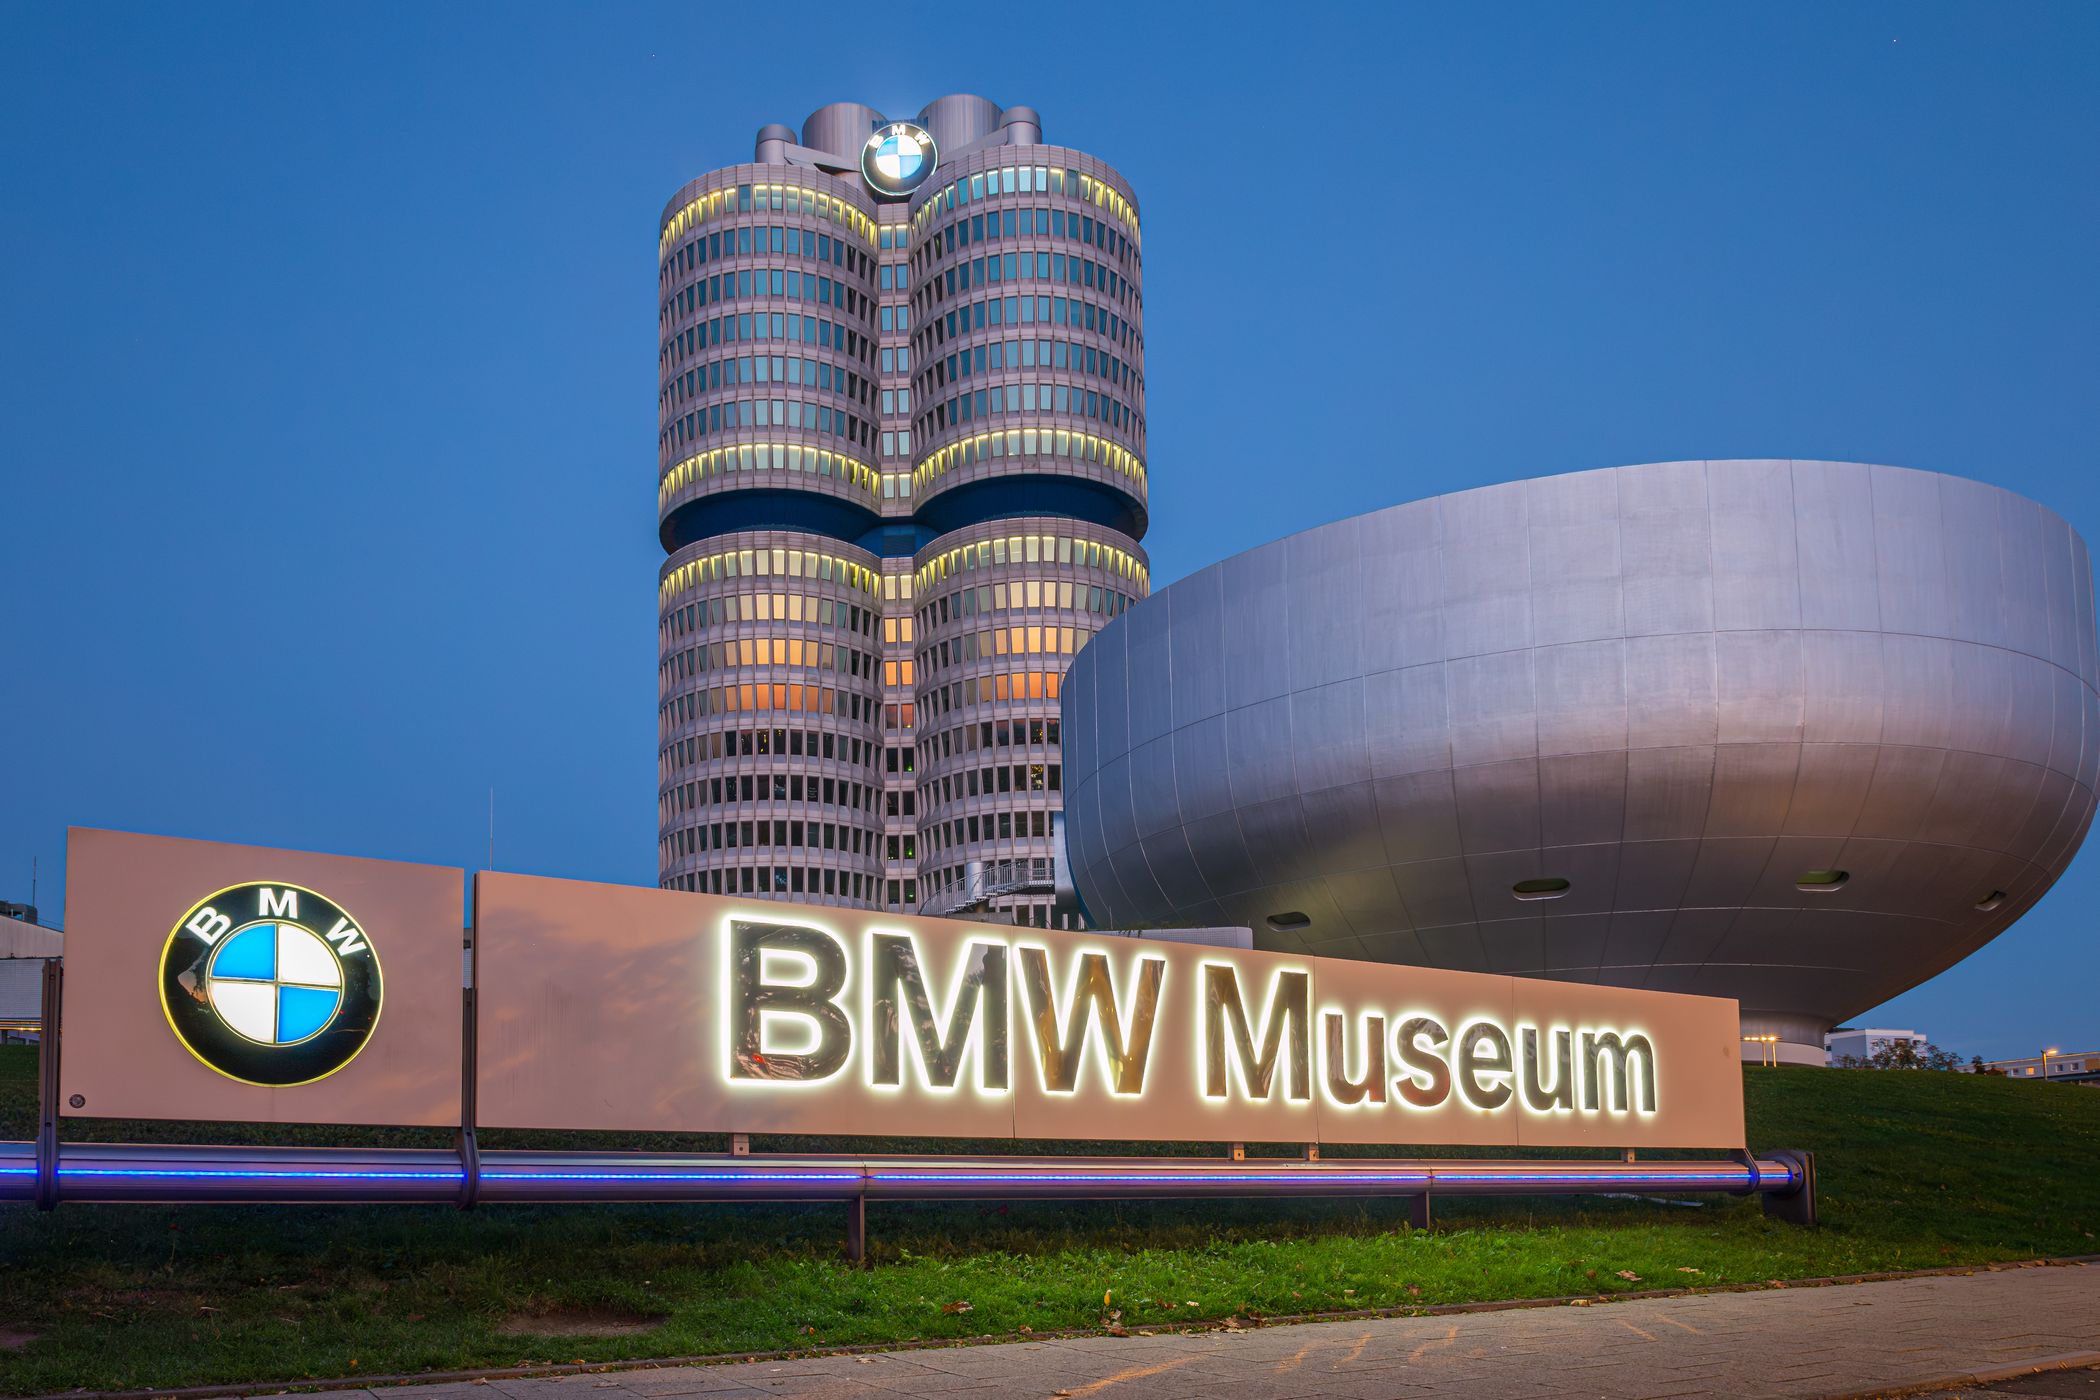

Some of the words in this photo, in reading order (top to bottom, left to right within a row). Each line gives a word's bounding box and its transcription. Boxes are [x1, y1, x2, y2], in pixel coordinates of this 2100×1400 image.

[868, 124, 931, 149] BMW
[185, 887, 367, 957] BMW
[727, 917, 1166, 1095] BMW
[1203, 962, 1657, 1113] Museum
